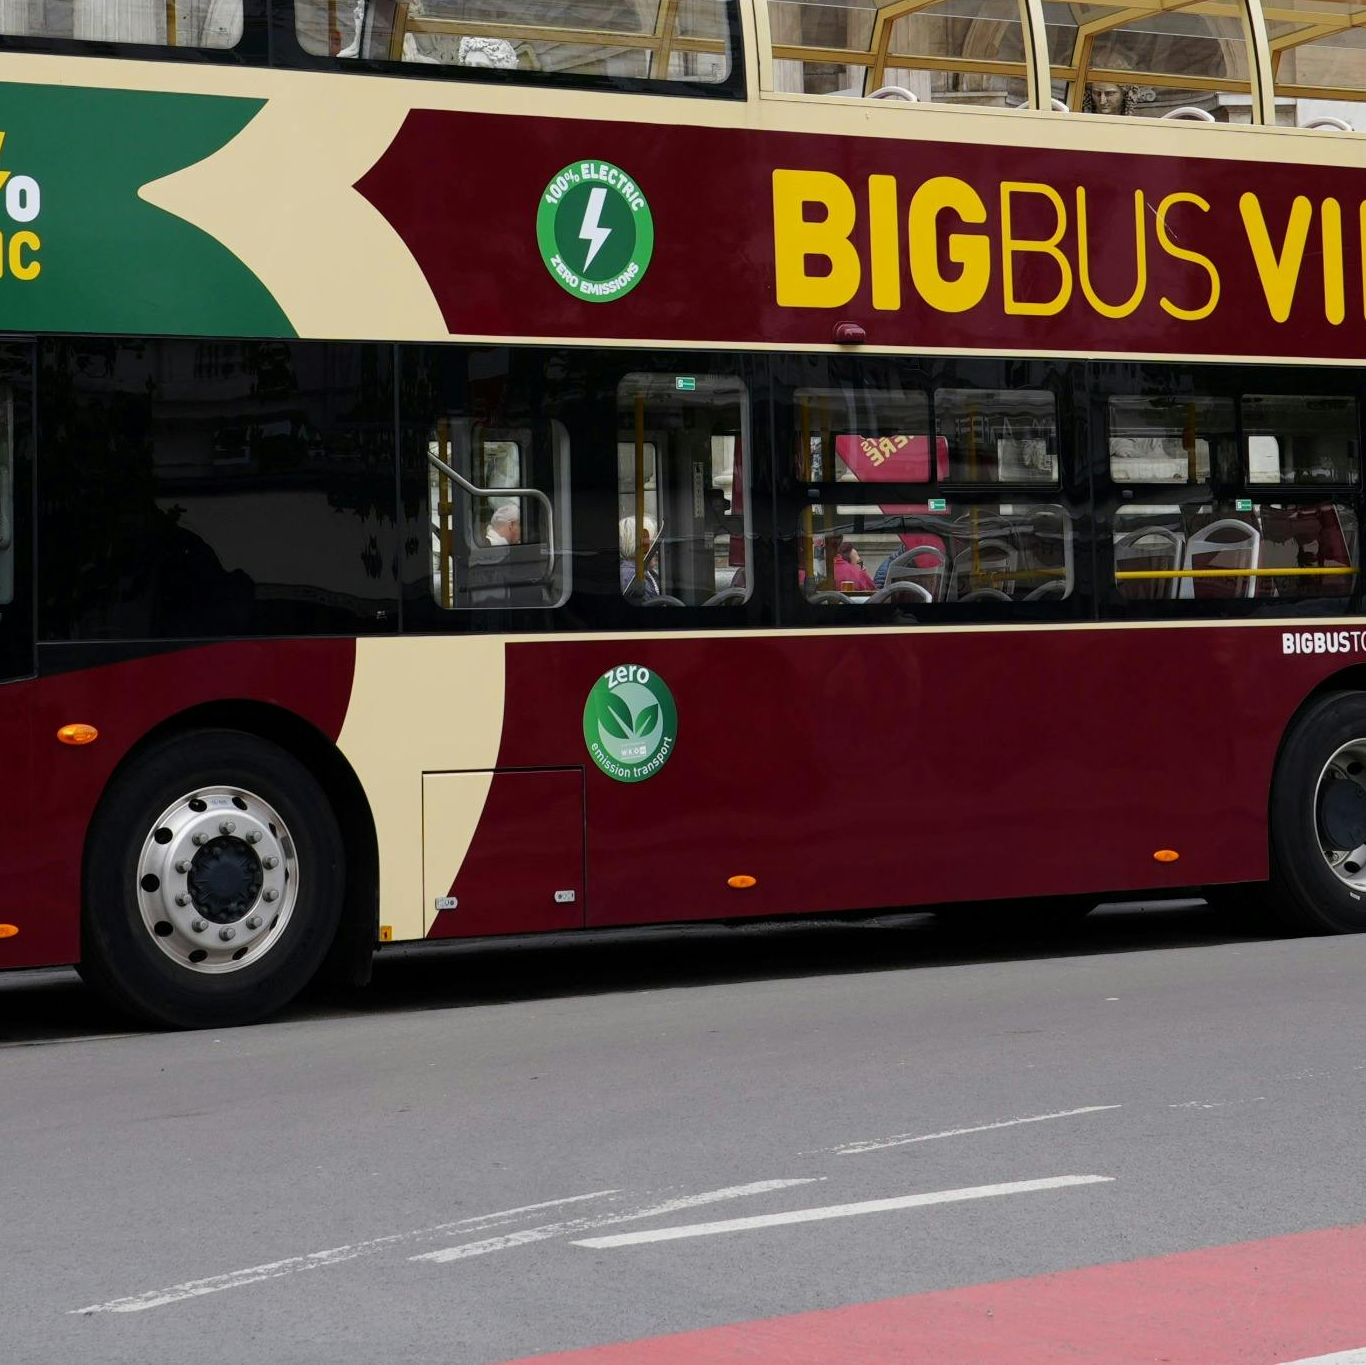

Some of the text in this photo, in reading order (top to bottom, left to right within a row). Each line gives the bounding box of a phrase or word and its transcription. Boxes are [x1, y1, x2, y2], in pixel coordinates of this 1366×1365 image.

[544, 163, 645, 212] 100% ELECTRIC
[550, 253, 640, 296] ZERO EMISSIONS
[604, 665, 650, 689] zero
[591, 737, 673, 778] emission transport
